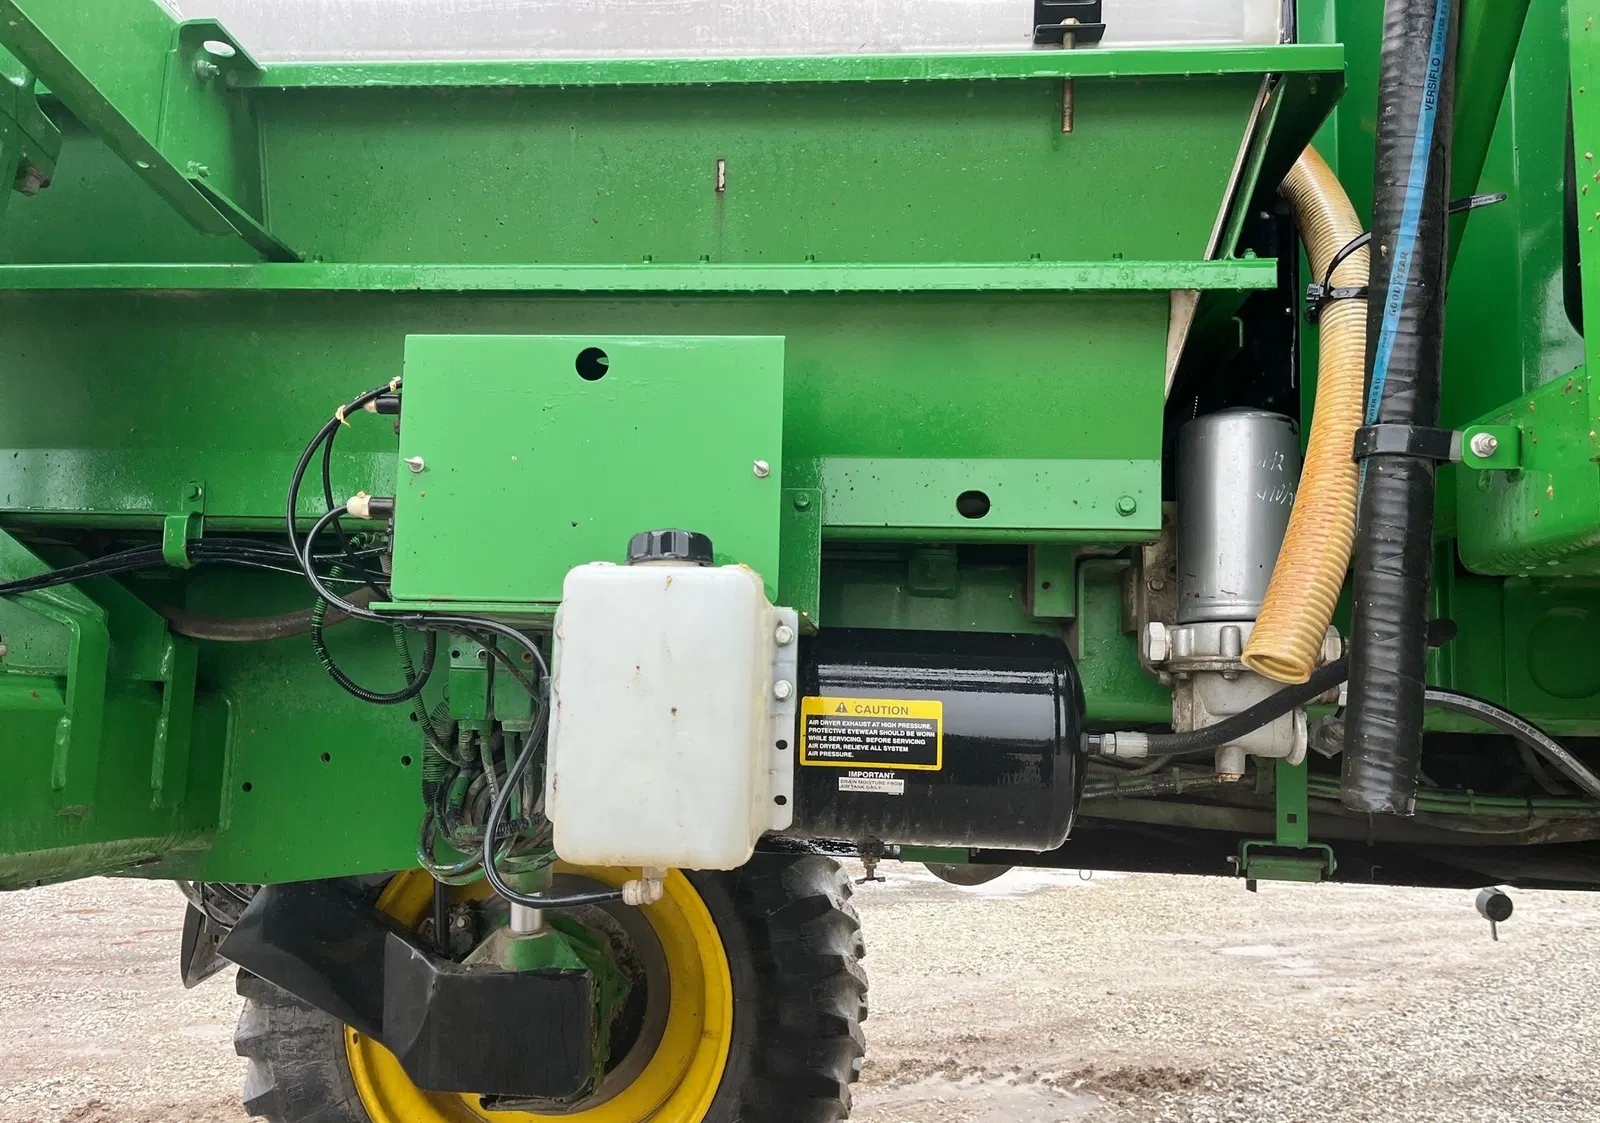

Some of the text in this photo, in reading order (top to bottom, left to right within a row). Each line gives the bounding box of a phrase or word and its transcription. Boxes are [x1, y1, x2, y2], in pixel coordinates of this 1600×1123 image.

[1424, 57, 1441, 111] VERSIFLO
[1437, 17, 1447, 42] WATER
[1388, 251, 1408, 316] GOODYEAR
[1367, 398, 1377, 424] WATER
[854, 704, 909, 715] CAUTION
[848, 770, 895, 779] IMPORTANT
